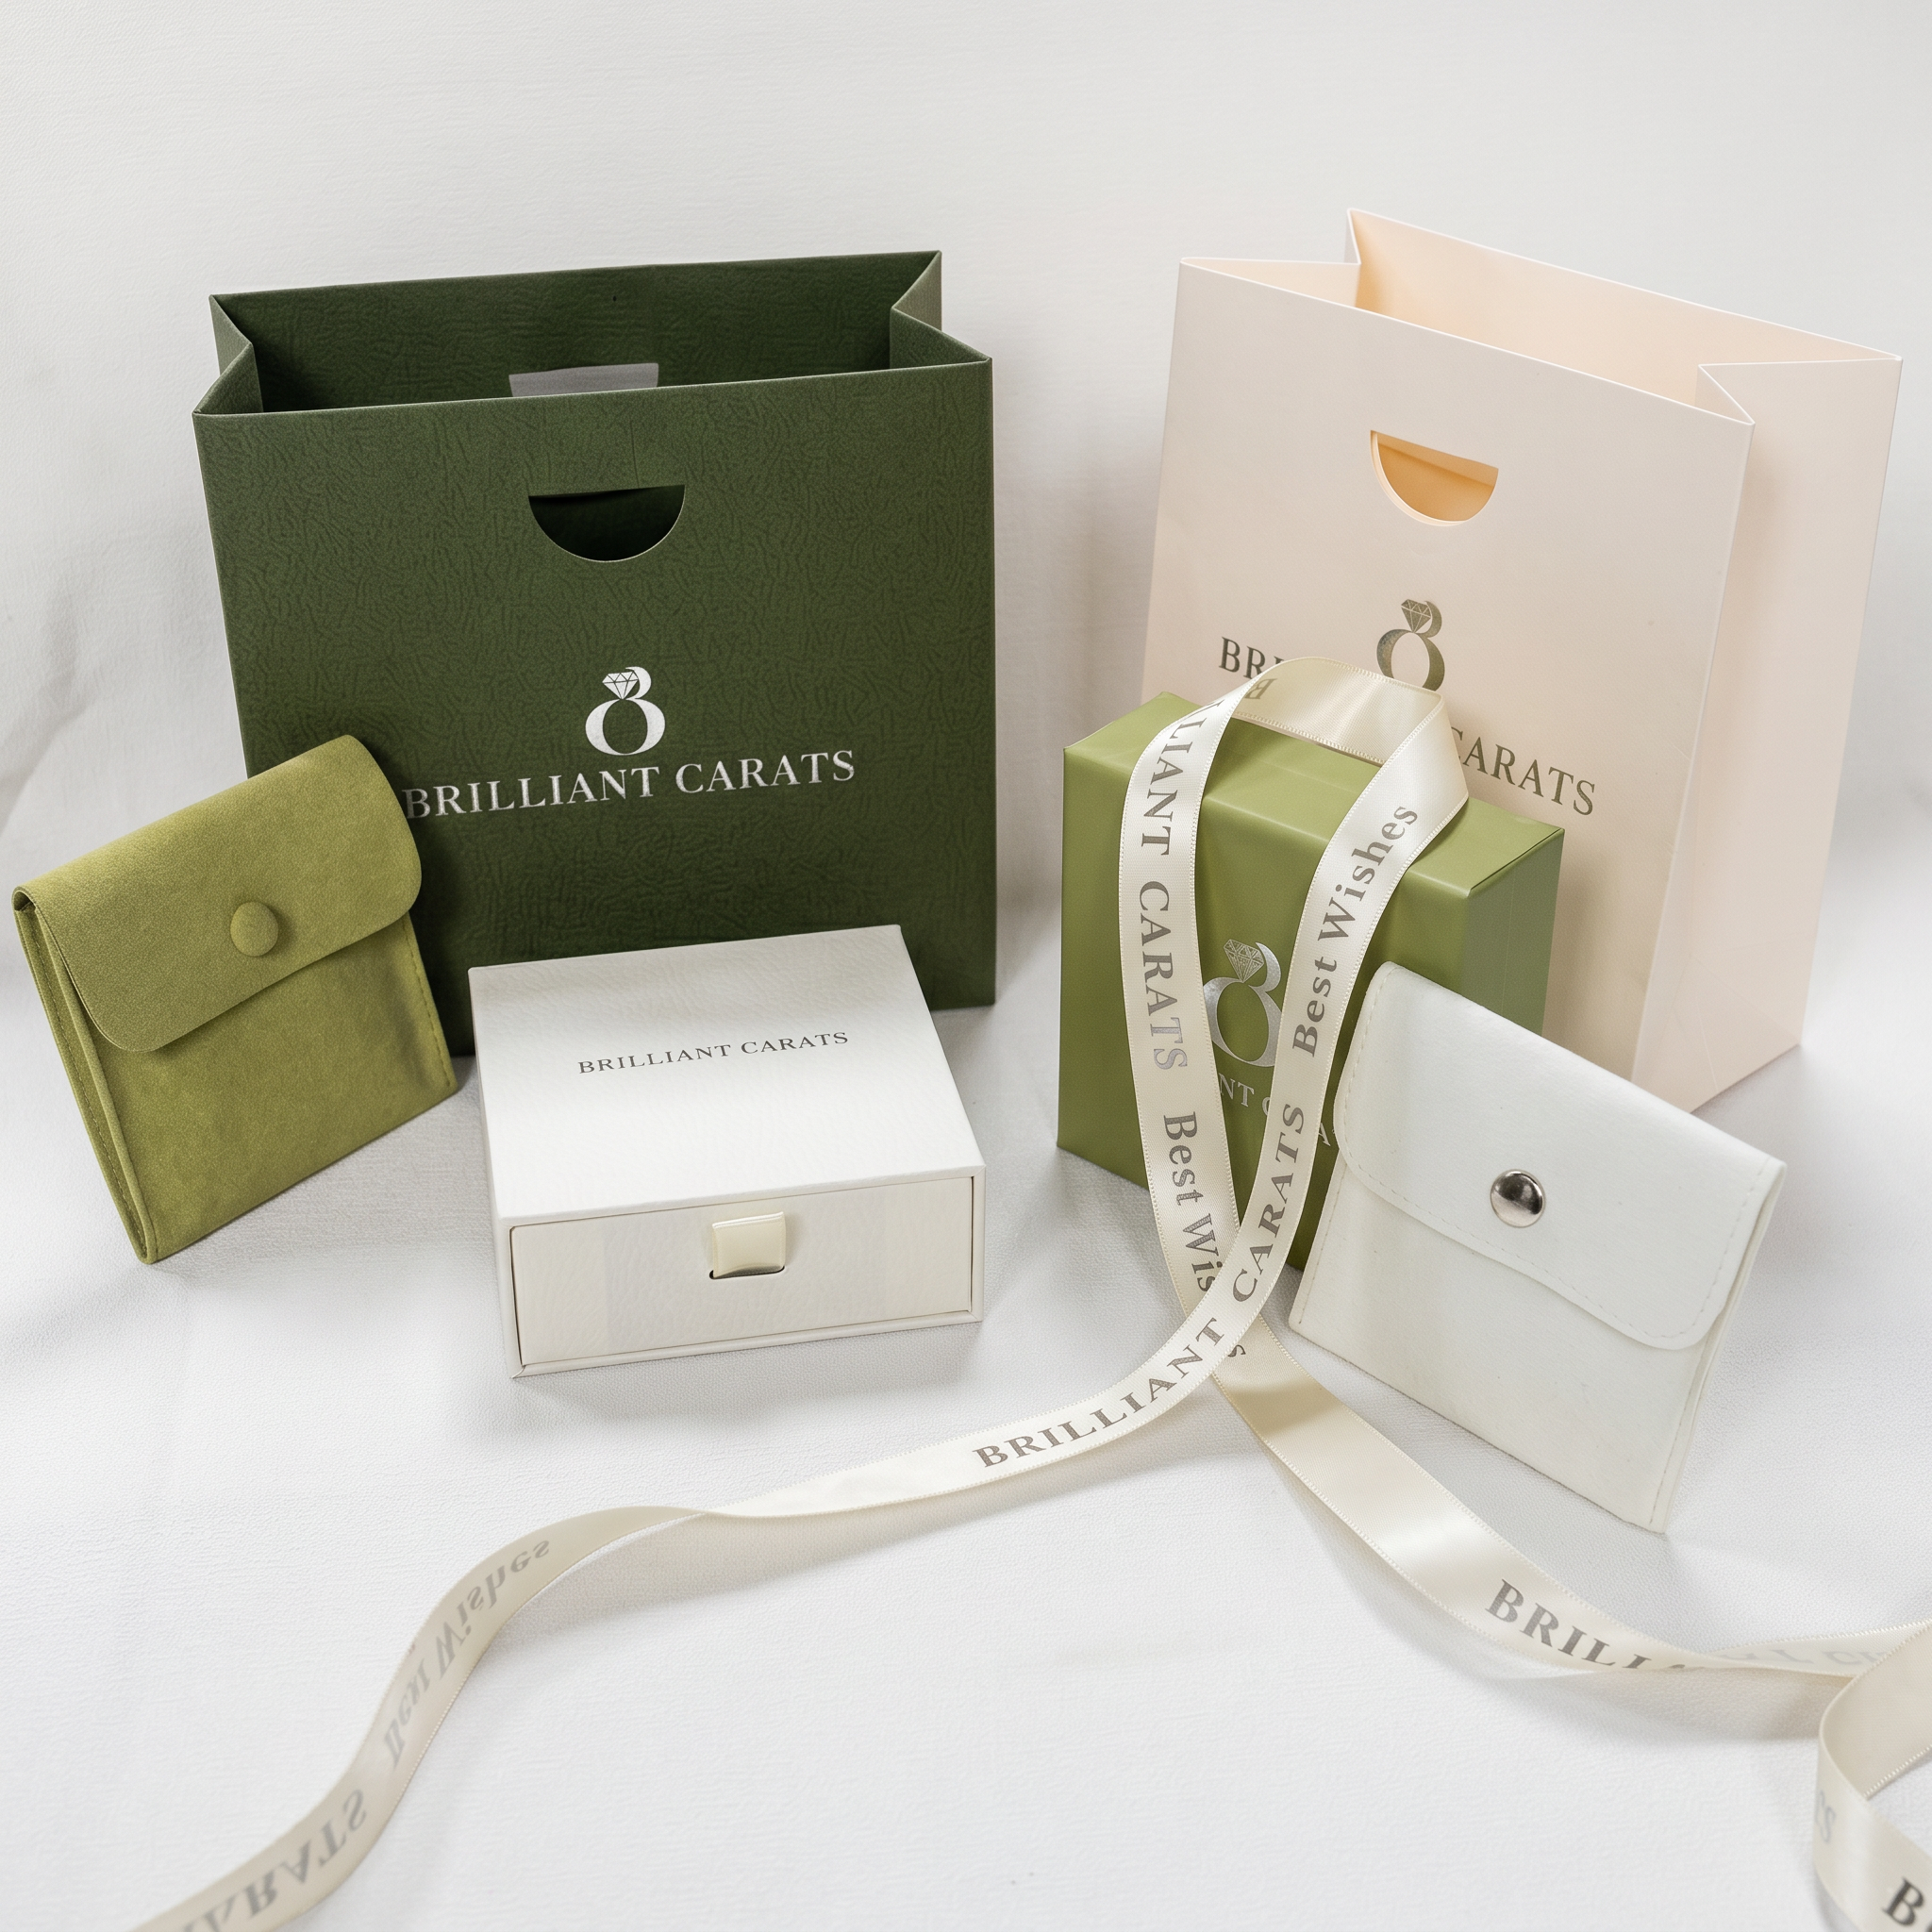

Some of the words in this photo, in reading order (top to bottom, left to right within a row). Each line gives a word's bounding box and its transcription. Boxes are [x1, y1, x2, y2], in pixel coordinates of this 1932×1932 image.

[402, 765, 660, 819] BRILLIANT
[675, 749, 856, 793] CARATS
[1139, 881, 1188, 1071] CARATS
[577, 1043, 731, 1074] BRILLIANT
[741, 1031, 849, 1055] CARATS
[972, 1317, 1225, 1468] BRILLIANT
[1232, 1103, 1305, 1303] CARATS
[1291, 956, 1338, 1058] Best
[1317, 805, 1418, 943] Wishes
[1163, 1111, 1204, 1207] Best
